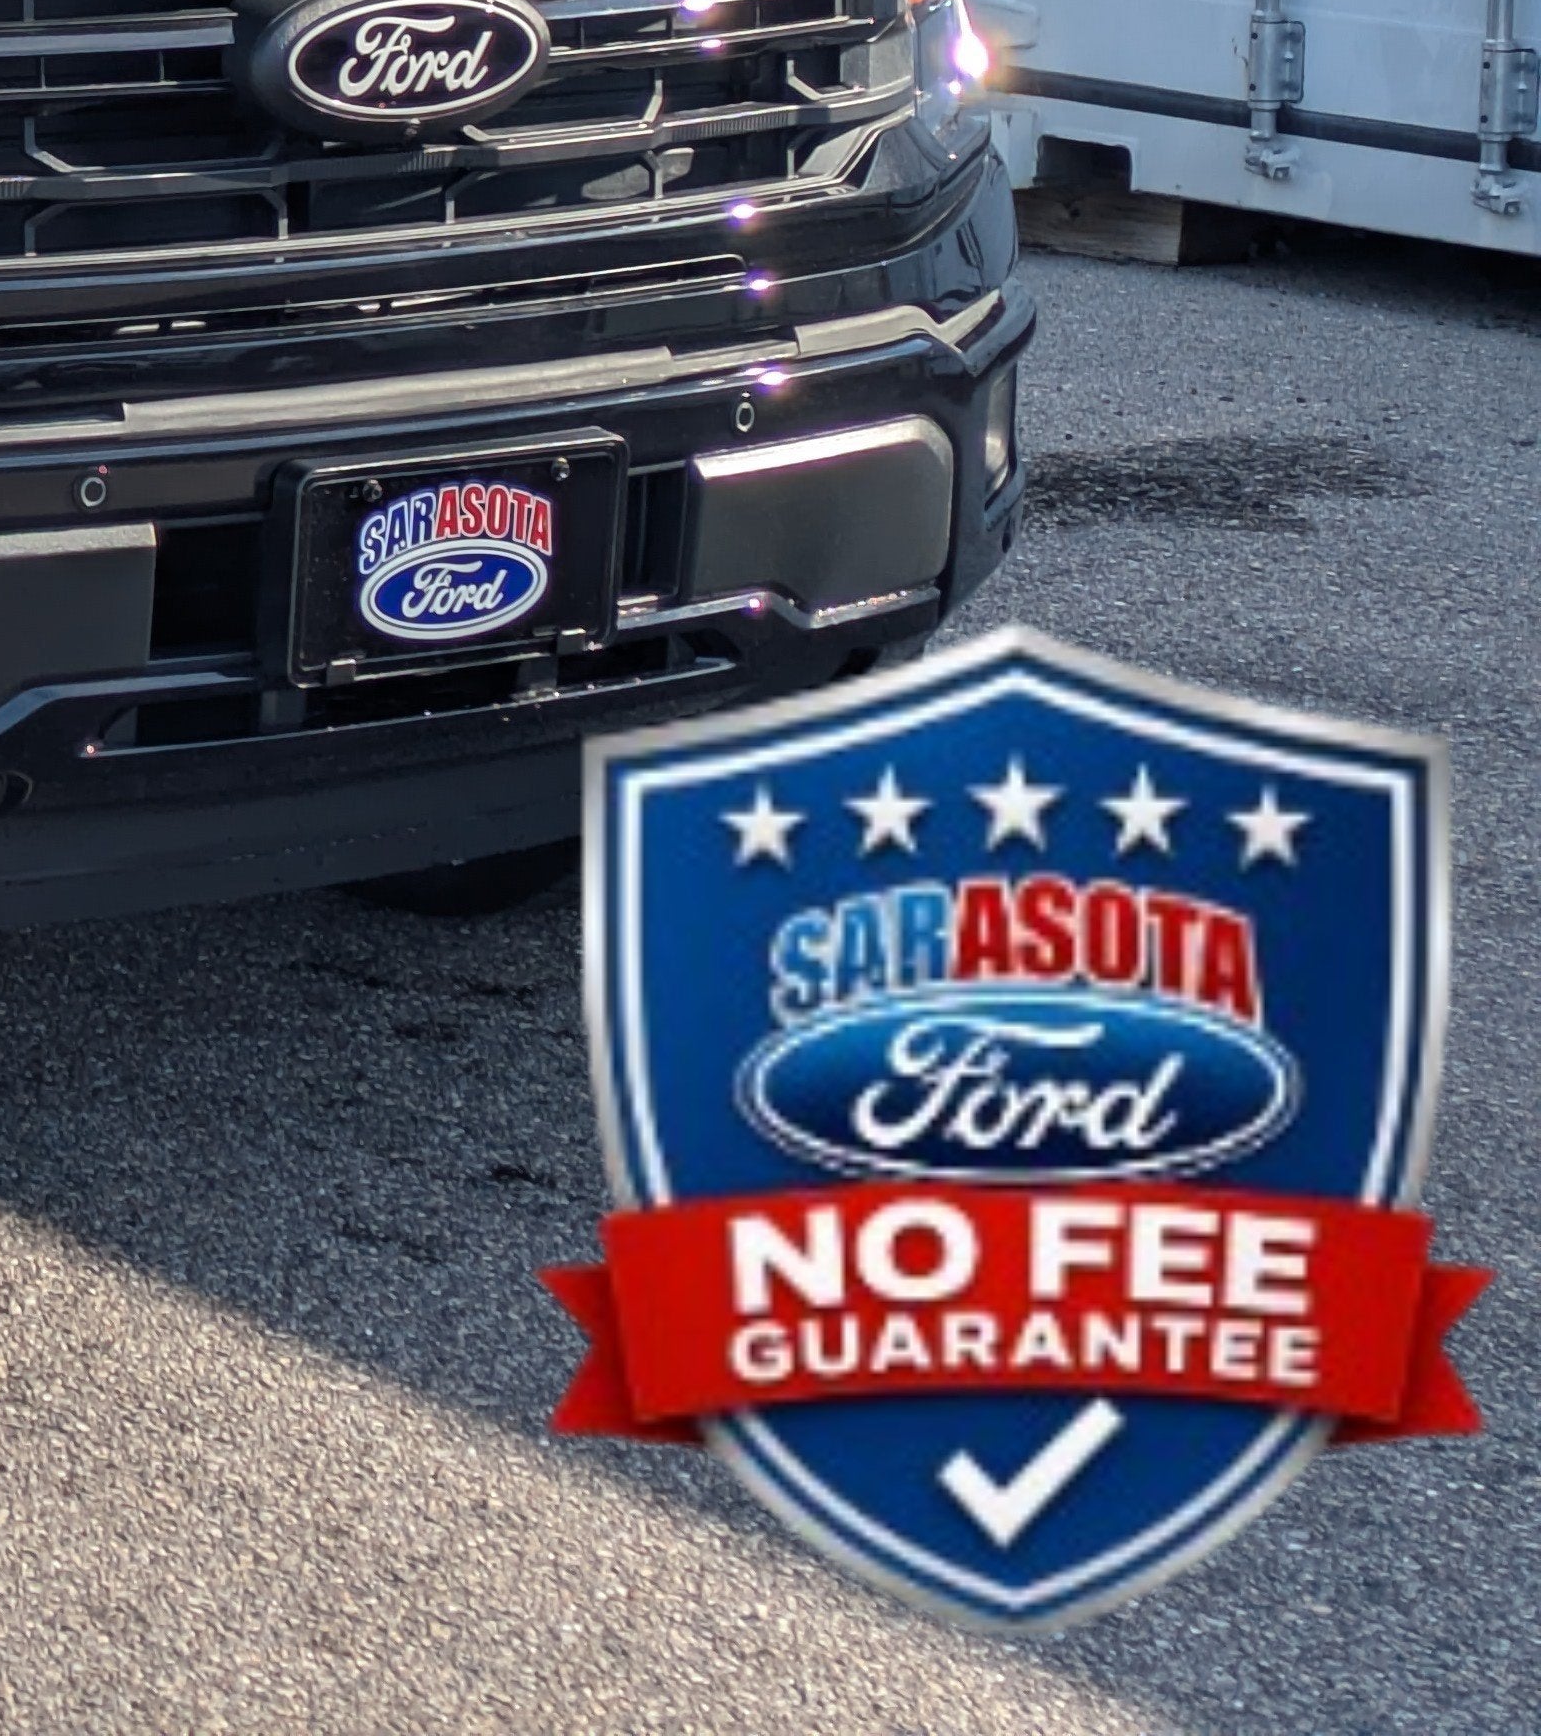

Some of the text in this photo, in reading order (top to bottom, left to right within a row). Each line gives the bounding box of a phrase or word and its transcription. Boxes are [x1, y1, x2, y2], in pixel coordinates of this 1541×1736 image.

[338, 15, 494, 98] Ford
[359, 483, 553, 575] SARASOTA
[401, 560, 504, 619] Ford
